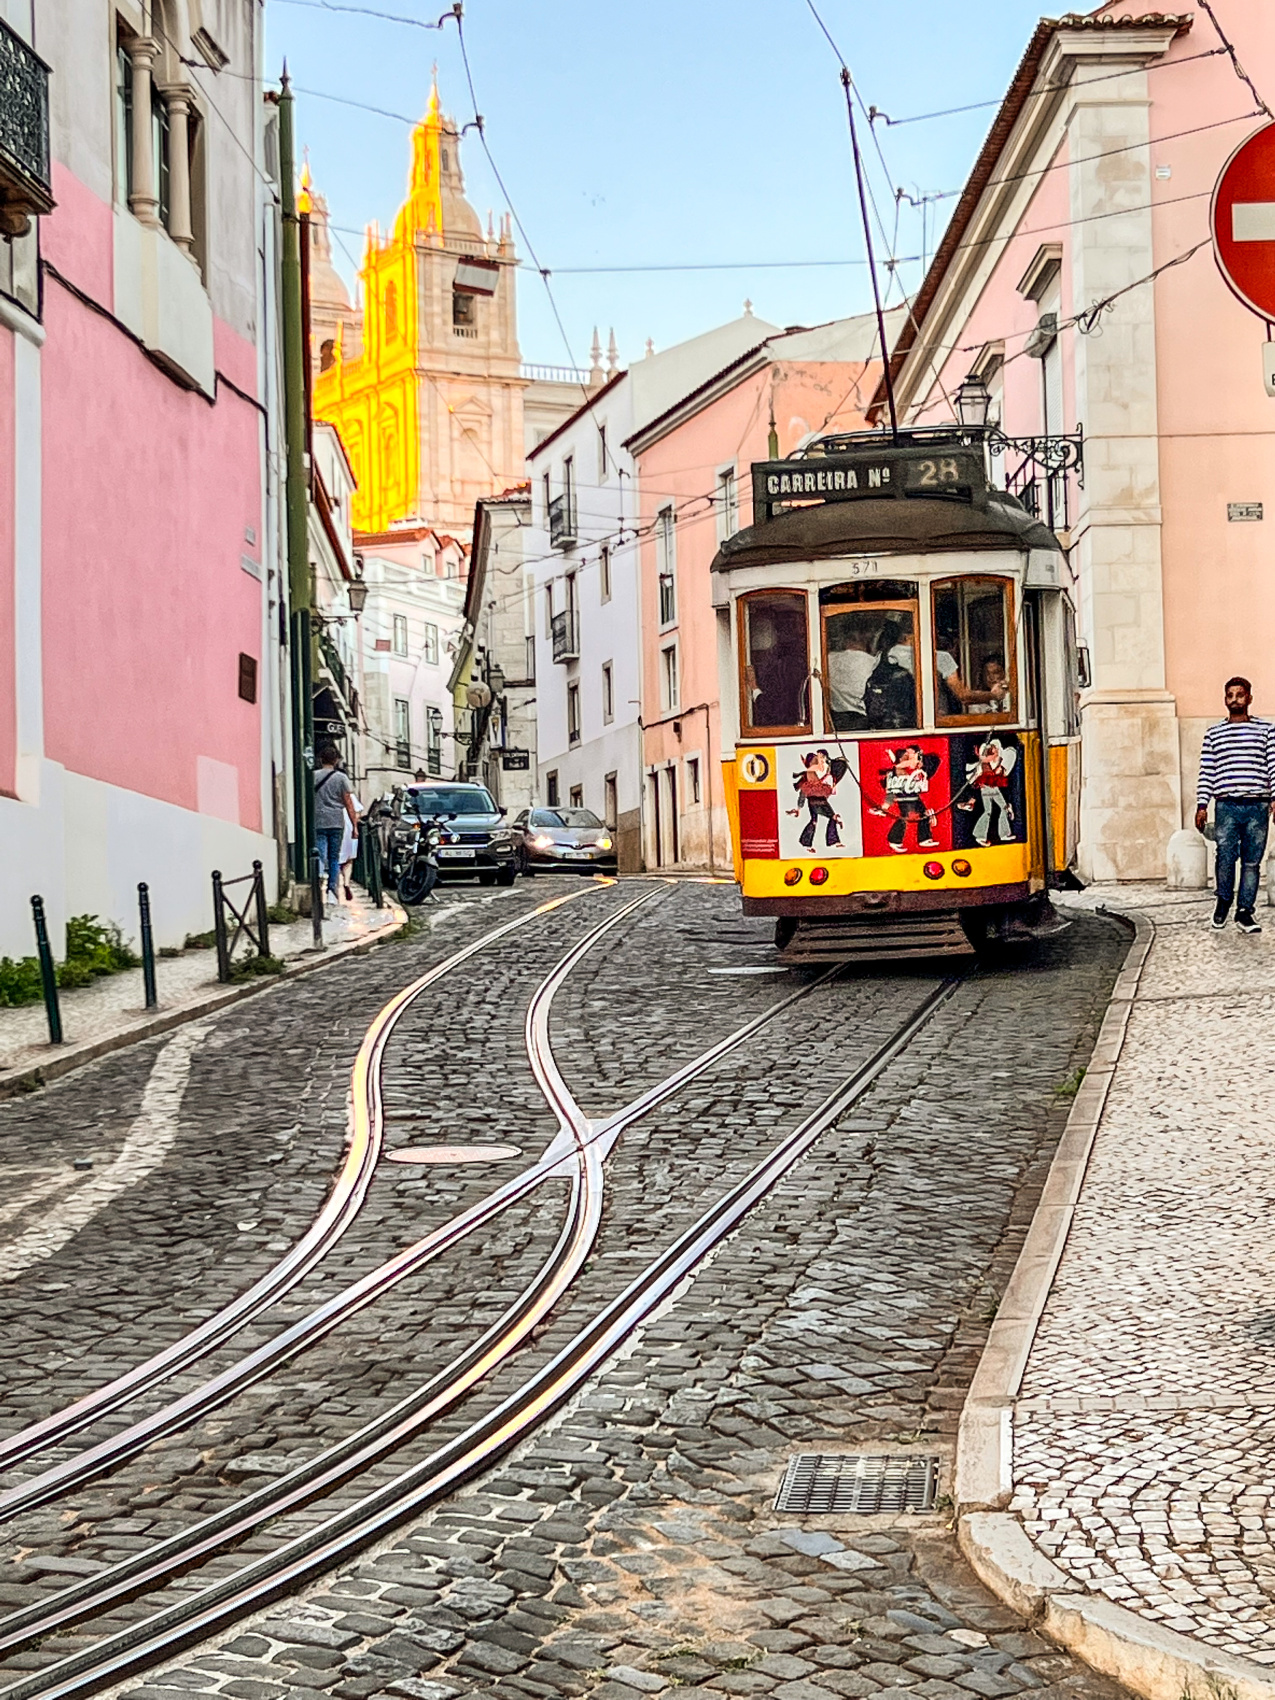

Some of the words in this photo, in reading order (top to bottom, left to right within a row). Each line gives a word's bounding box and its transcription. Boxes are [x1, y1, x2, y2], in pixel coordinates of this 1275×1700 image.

[767, 470, 858, 494] CARREIRA
[918, 458, 959, 486] 28
[851, 560, 878, 575] 571
